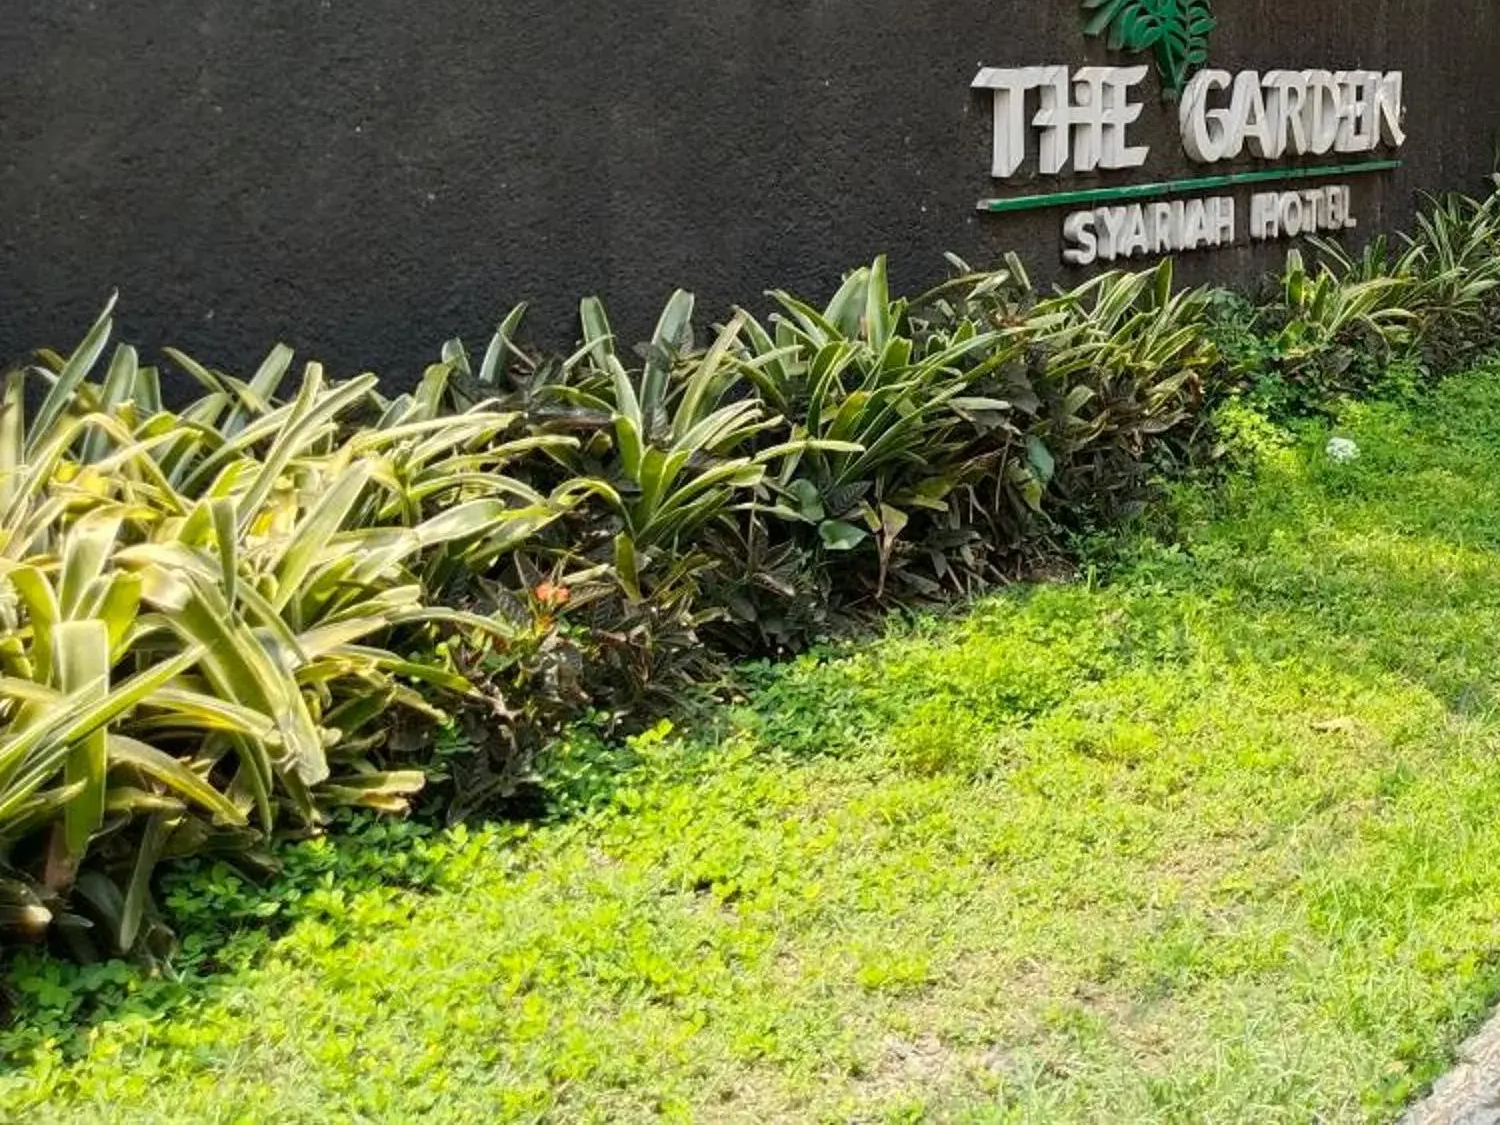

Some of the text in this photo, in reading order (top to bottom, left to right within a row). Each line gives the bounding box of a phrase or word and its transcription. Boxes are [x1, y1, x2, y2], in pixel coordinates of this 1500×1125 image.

[970, 64, 1407, 177] THE GARDEN
[1063, 185, 1357, 265] SYARIAH HOTEL
